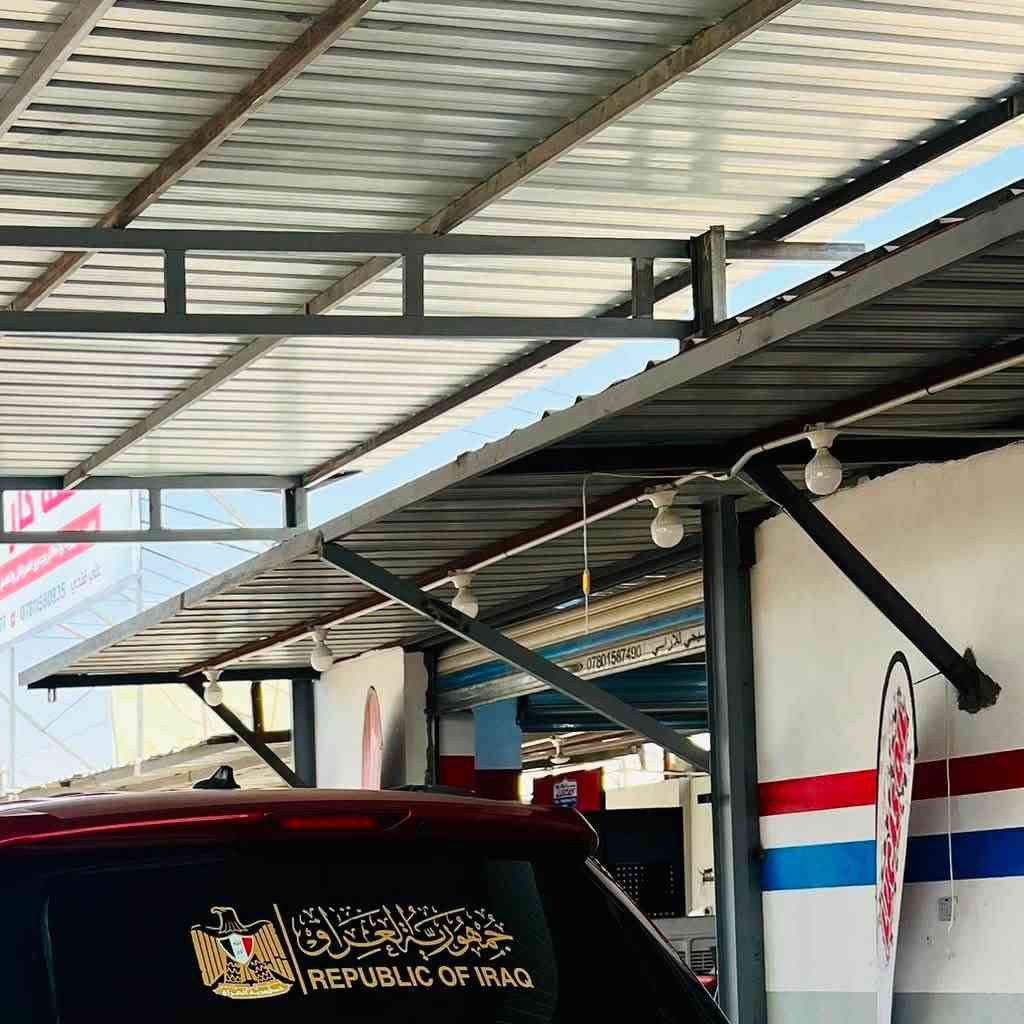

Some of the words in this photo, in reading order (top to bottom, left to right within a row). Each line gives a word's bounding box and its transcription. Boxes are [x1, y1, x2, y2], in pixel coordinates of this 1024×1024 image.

[308, 966, 434, 990] REPUBLIC
[438, 966, 471, 988] OF
[473, 967, 535, 989] IRAQ
